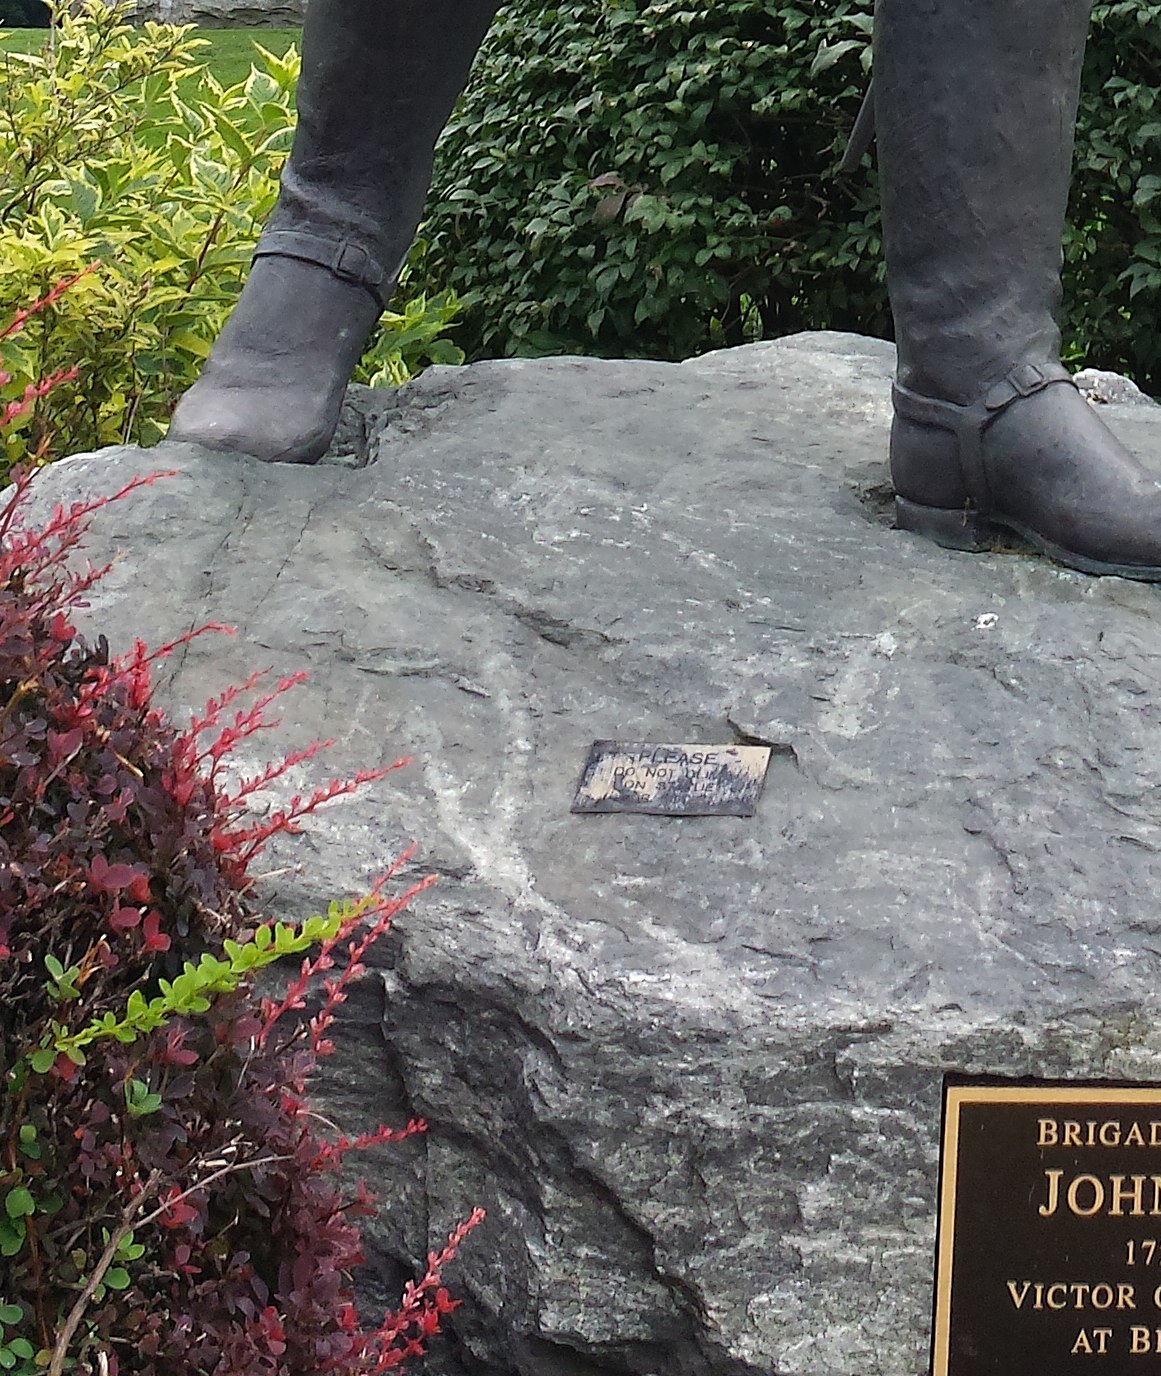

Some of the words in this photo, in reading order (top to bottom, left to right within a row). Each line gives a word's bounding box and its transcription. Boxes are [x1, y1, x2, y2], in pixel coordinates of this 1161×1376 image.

[638, 748, 719, 766] PLEASE
[614, 766, 636, 776] DO
[645, 767, 675, 778] NOT
[624, 780, 647, 791] ON
[1007, 1281, 1137, 1310] VICTOR
[1070, 1328, 1113, 1355] AT
